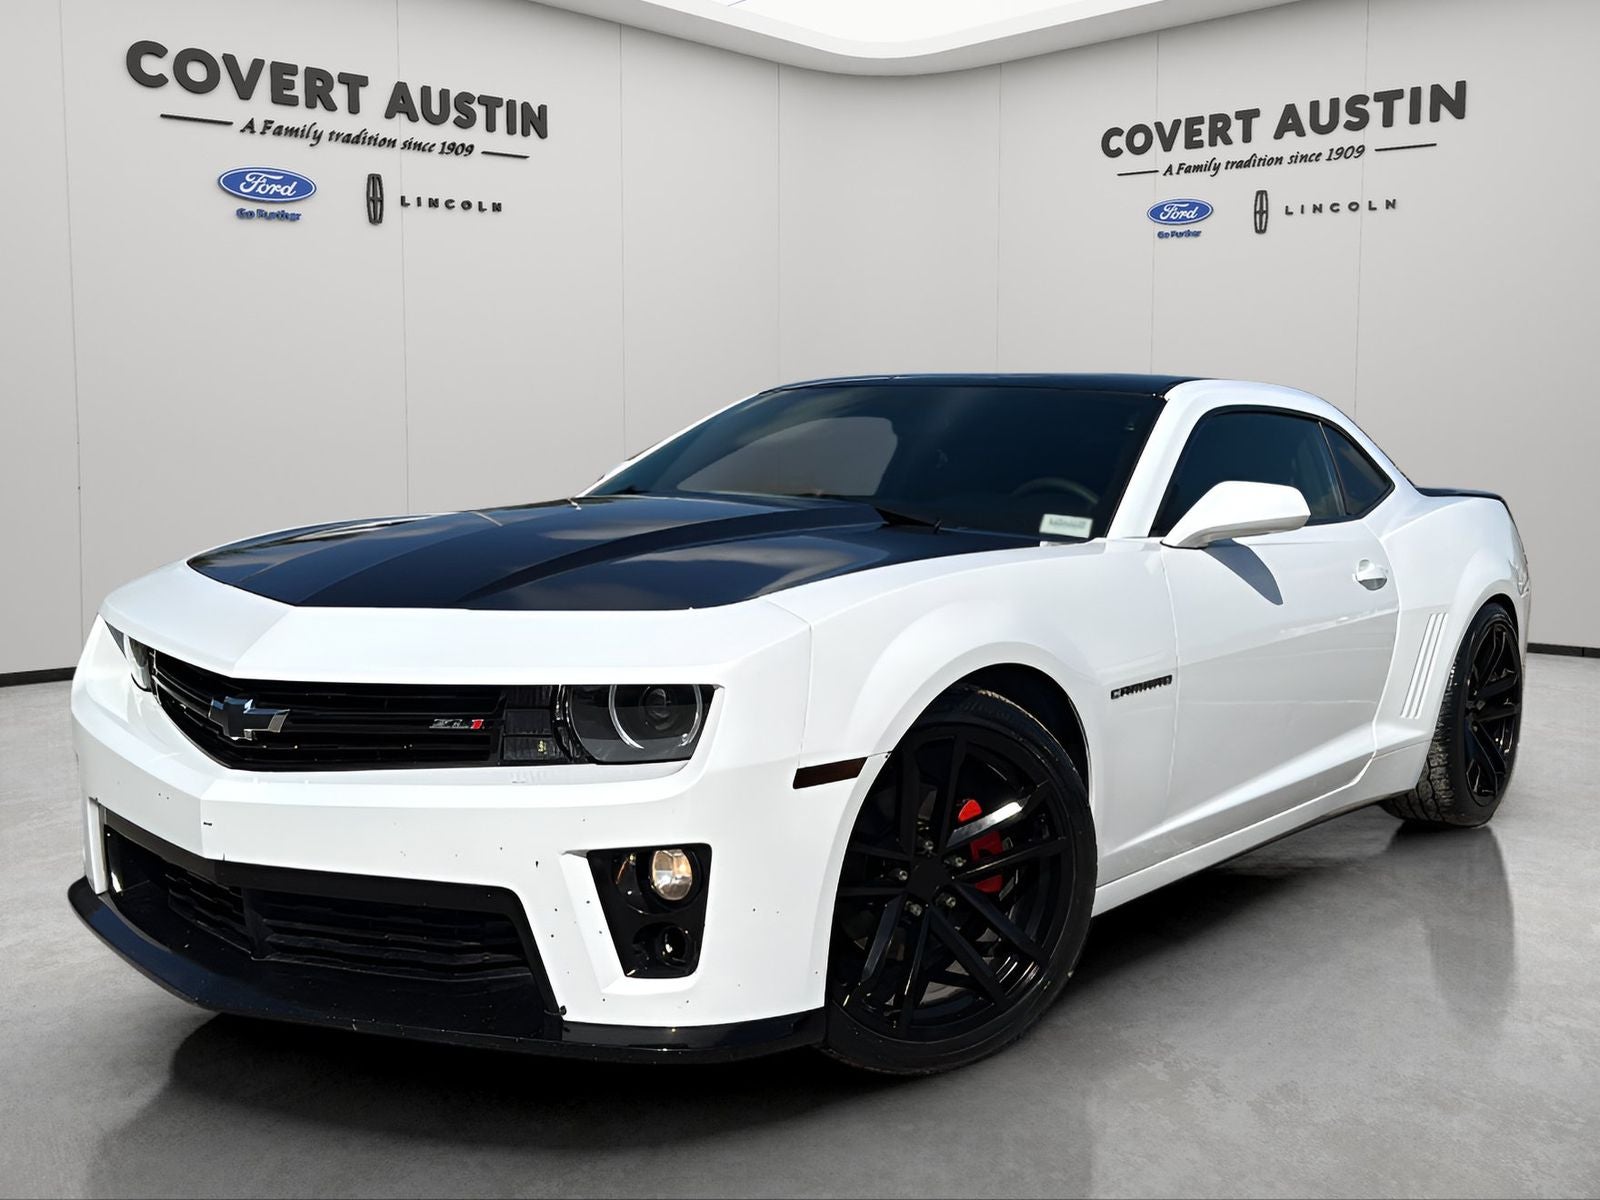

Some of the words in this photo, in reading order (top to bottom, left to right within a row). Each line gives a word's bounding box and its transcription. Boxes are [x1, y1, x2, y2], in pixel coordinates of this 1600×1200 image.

[125, 40, 369, 116] COVERT
[384, 81, 549, 139] AUSTIN
[1101, 108, 1261, 158] COVERT
[1273, 80, 1467, 140] AUSTIN
[240, 117, 257, 135] A
[259, 119, 324, 147] Family
[328, 128, 398, 149] tradition
[400, 136, 437, 154] since
[438, 141, 475, 158] 1909
[1162, 163, 1174, 177] A
[1175, 157, 1222, 178] Family
[1224, 153, 1284, 170] tradition
[1287, 151, 1323, 165] since
[1325, 144, 1366, 162] 1909
[239, 172, 298, 197] Ford
[236, 208, 255, 220] Go
[400, 196, 503, 214] LINCOLN
[1159, 203, 1200, 220] Ford
[1285, 198, 1397, 215] LINCOLN
[1157, 230, 1170, 239] Go
